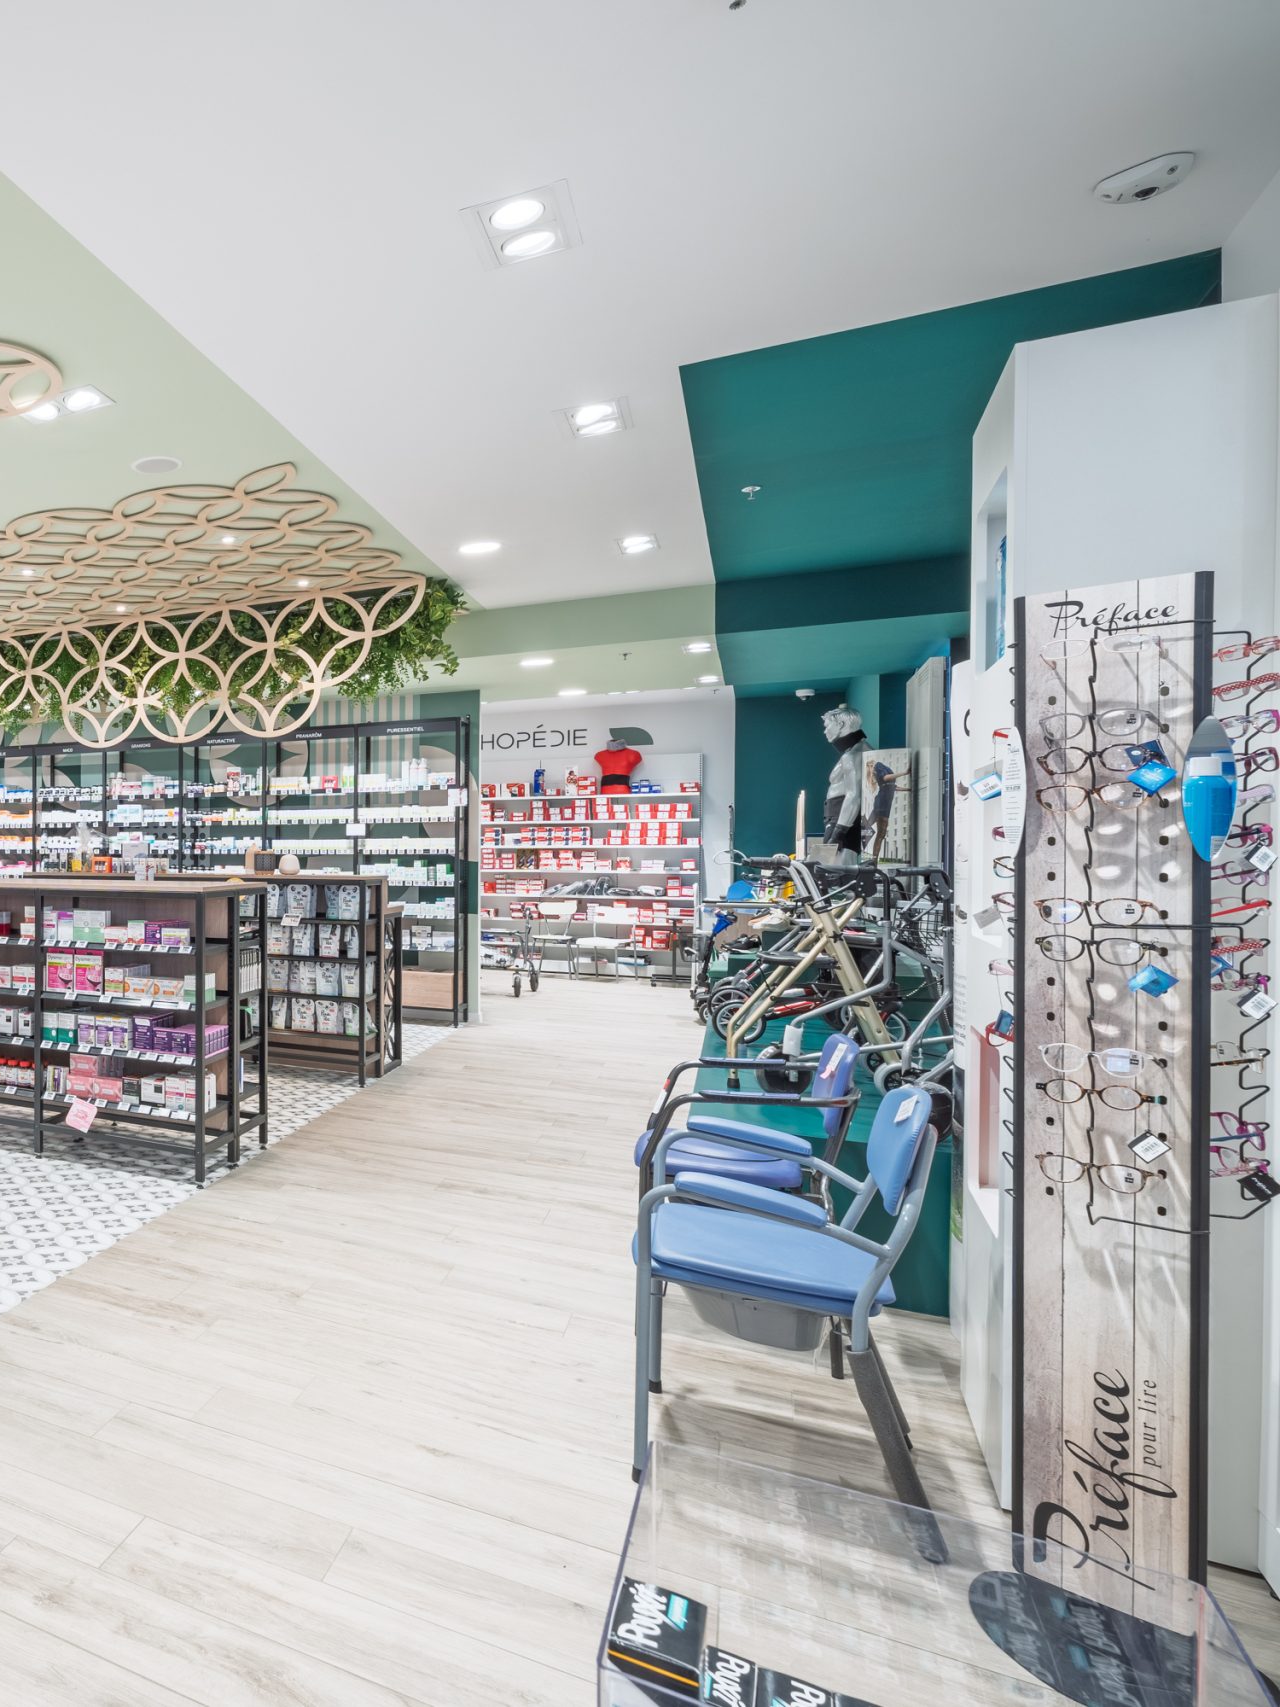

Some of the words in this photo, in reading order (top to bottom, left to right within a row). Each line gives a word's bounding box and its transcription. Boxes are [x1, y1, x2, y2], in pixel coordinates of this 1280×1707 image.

[1044, 601, 1179, 638] Préface
[386, 726, 425, 734] PURESSENTIEL
[480, 724, 588, 750] HOPÉDIE
[1138, 1379, 1157, 1415] lire
[1142, 1422, 1162, 1469] pour
[1033, 1368, 1178, 1591] Préface
